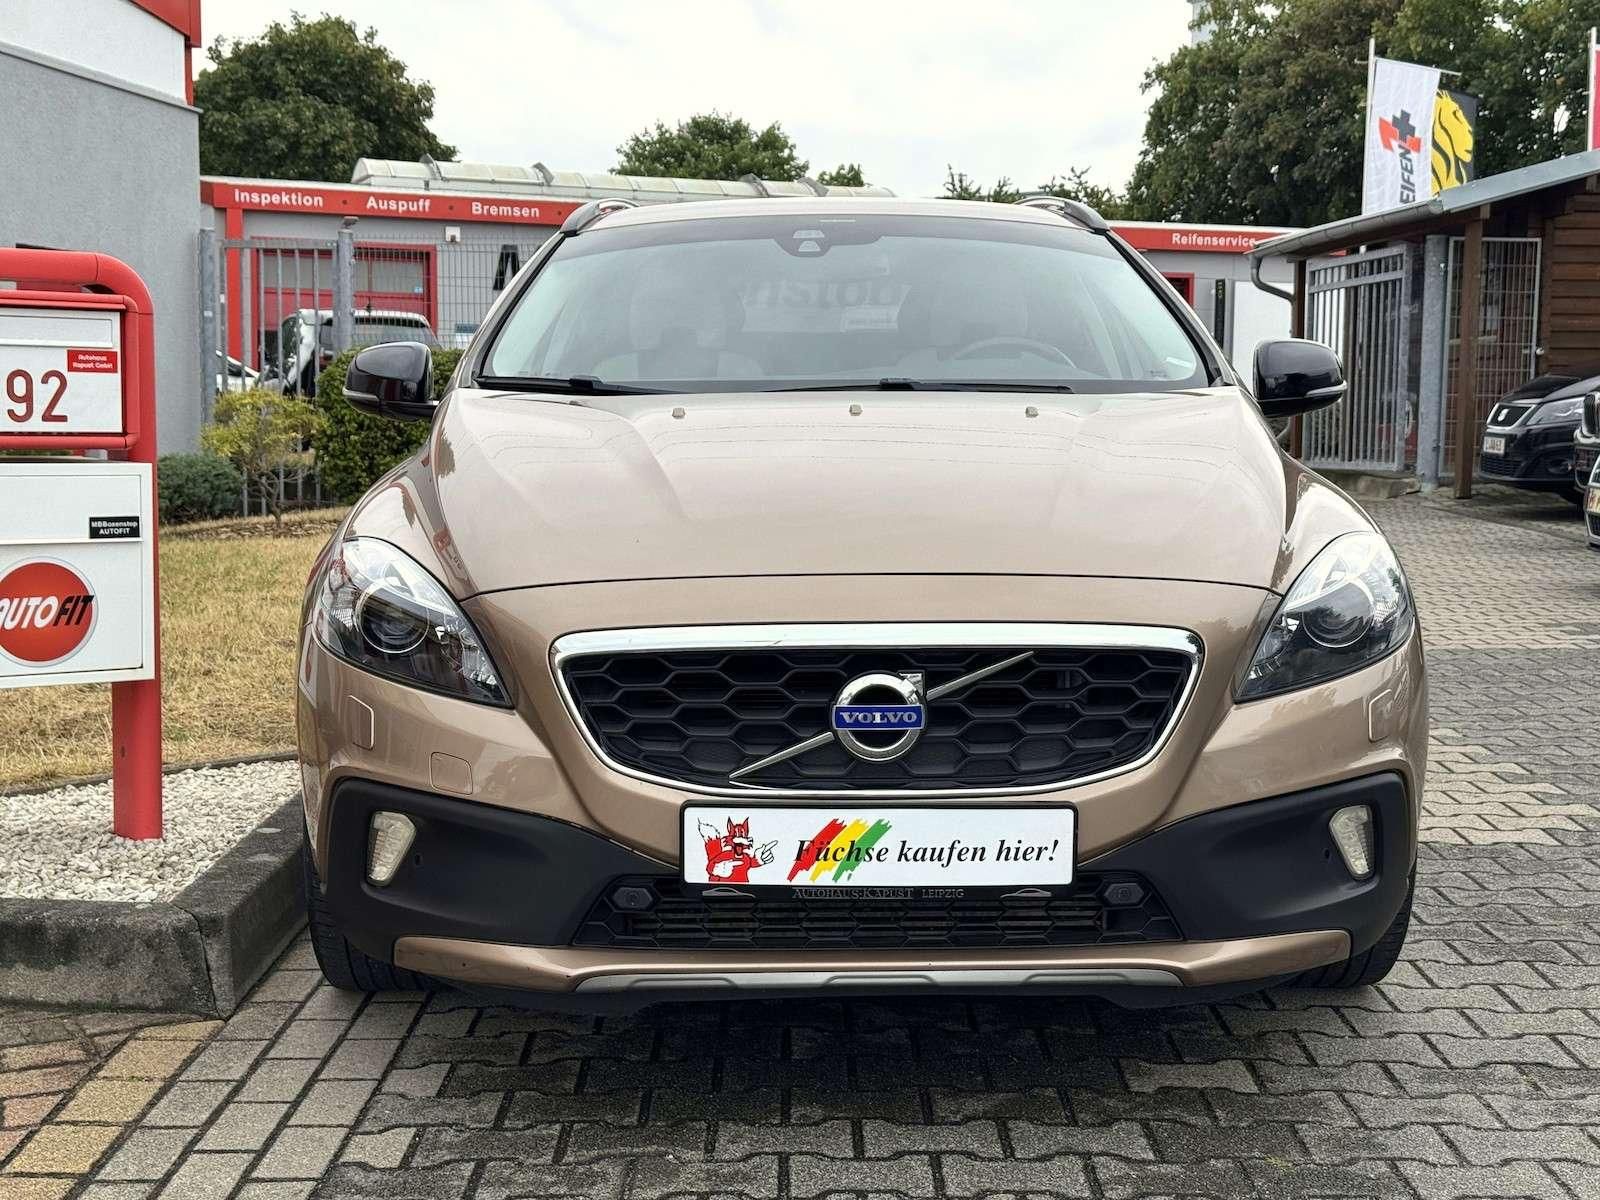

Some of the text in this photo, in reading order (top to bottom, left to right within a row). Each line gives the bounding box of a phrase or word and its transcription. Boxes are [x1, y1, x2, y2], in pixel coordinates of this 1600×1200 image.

[234, 188, 540, 218] Inspektion Auspuff Bremsen
[1171, 232, 1255, 247] Reifenservice
[6, 369, 69, 423] 92
[99, 527, 130, 535] AUTOFIT
[0, 595, 95, 631] AUTOFIT
[839, 711, 918, 724] VOLVO
[794, 839, 1060, 868] Füchse kaufen hier!
[922, 888, 965, 898] LEIPZIG
